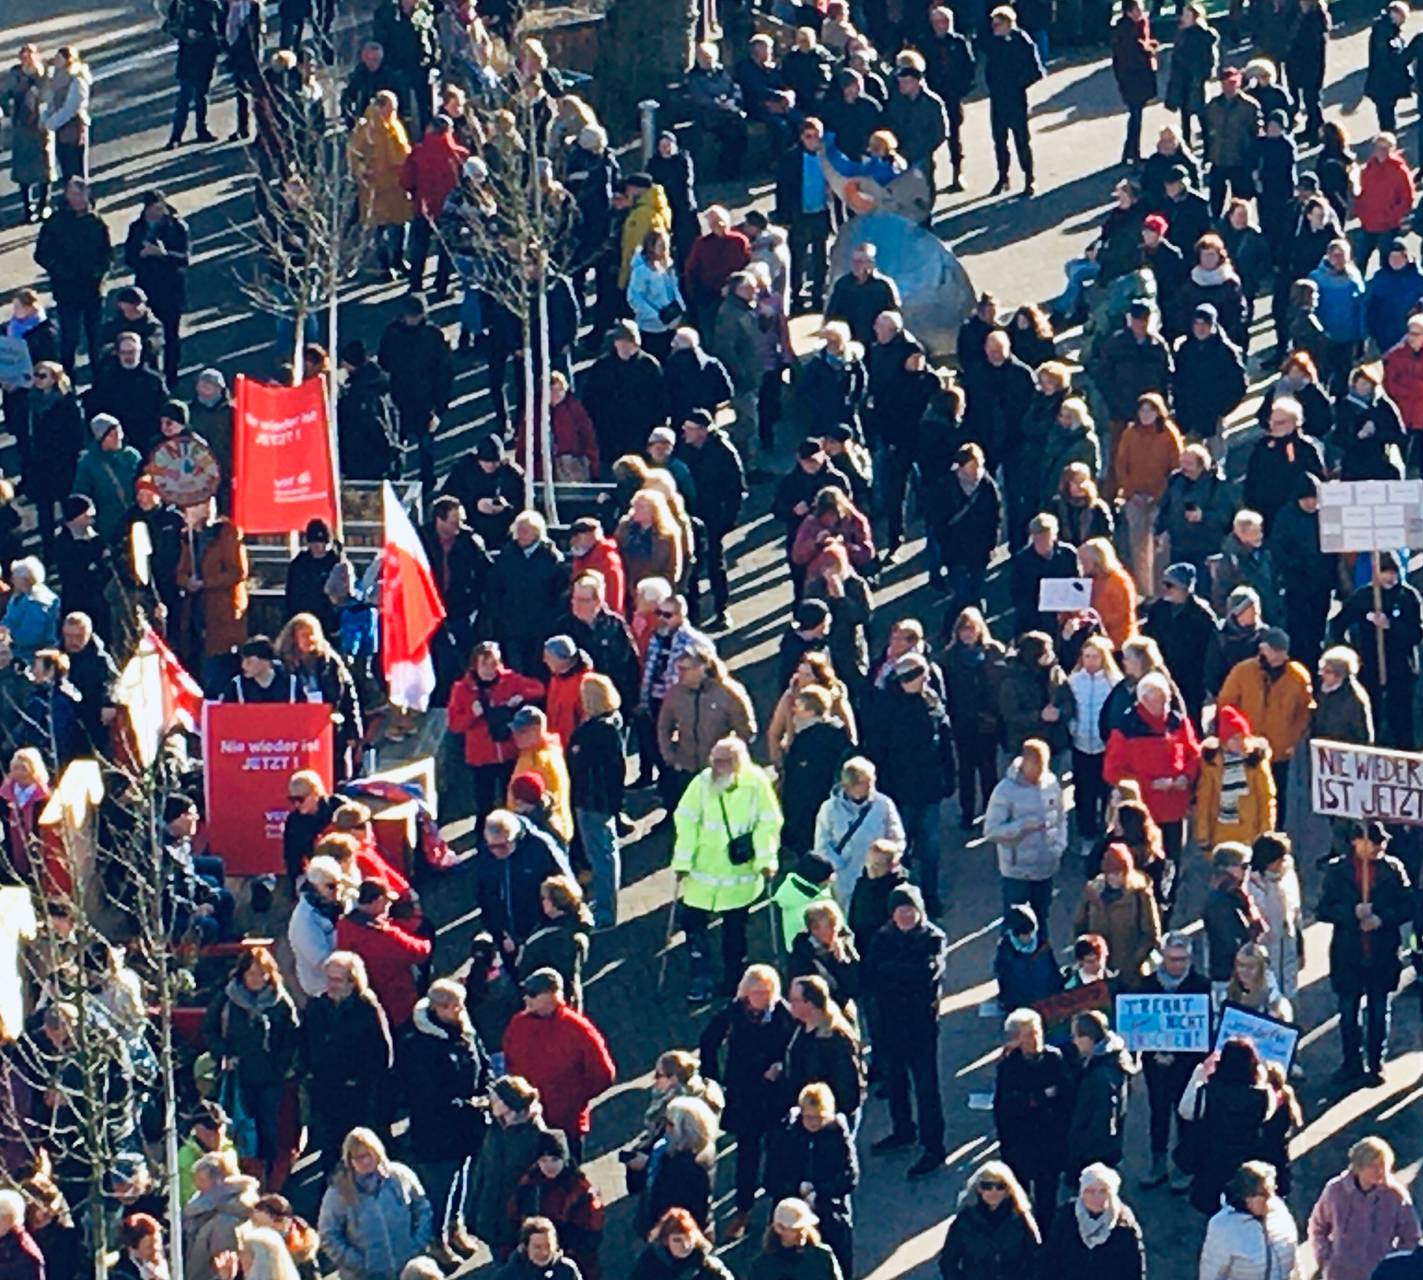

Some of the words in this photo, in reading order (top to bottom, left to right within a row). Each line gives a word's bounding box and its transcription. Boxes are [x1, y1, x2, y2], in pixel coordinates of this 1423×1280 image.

[220, 739, 245, 754] Nie
[248, 739, 298, 753] wieder
[301, 739, 320, 752] ist
[242, 756, 289, 770] JETZT
[1318, 748, 1350, 777] NIE
[1355, 752, 1423, 787] WIEDER
[1318, 778, 1354, 812] IST
